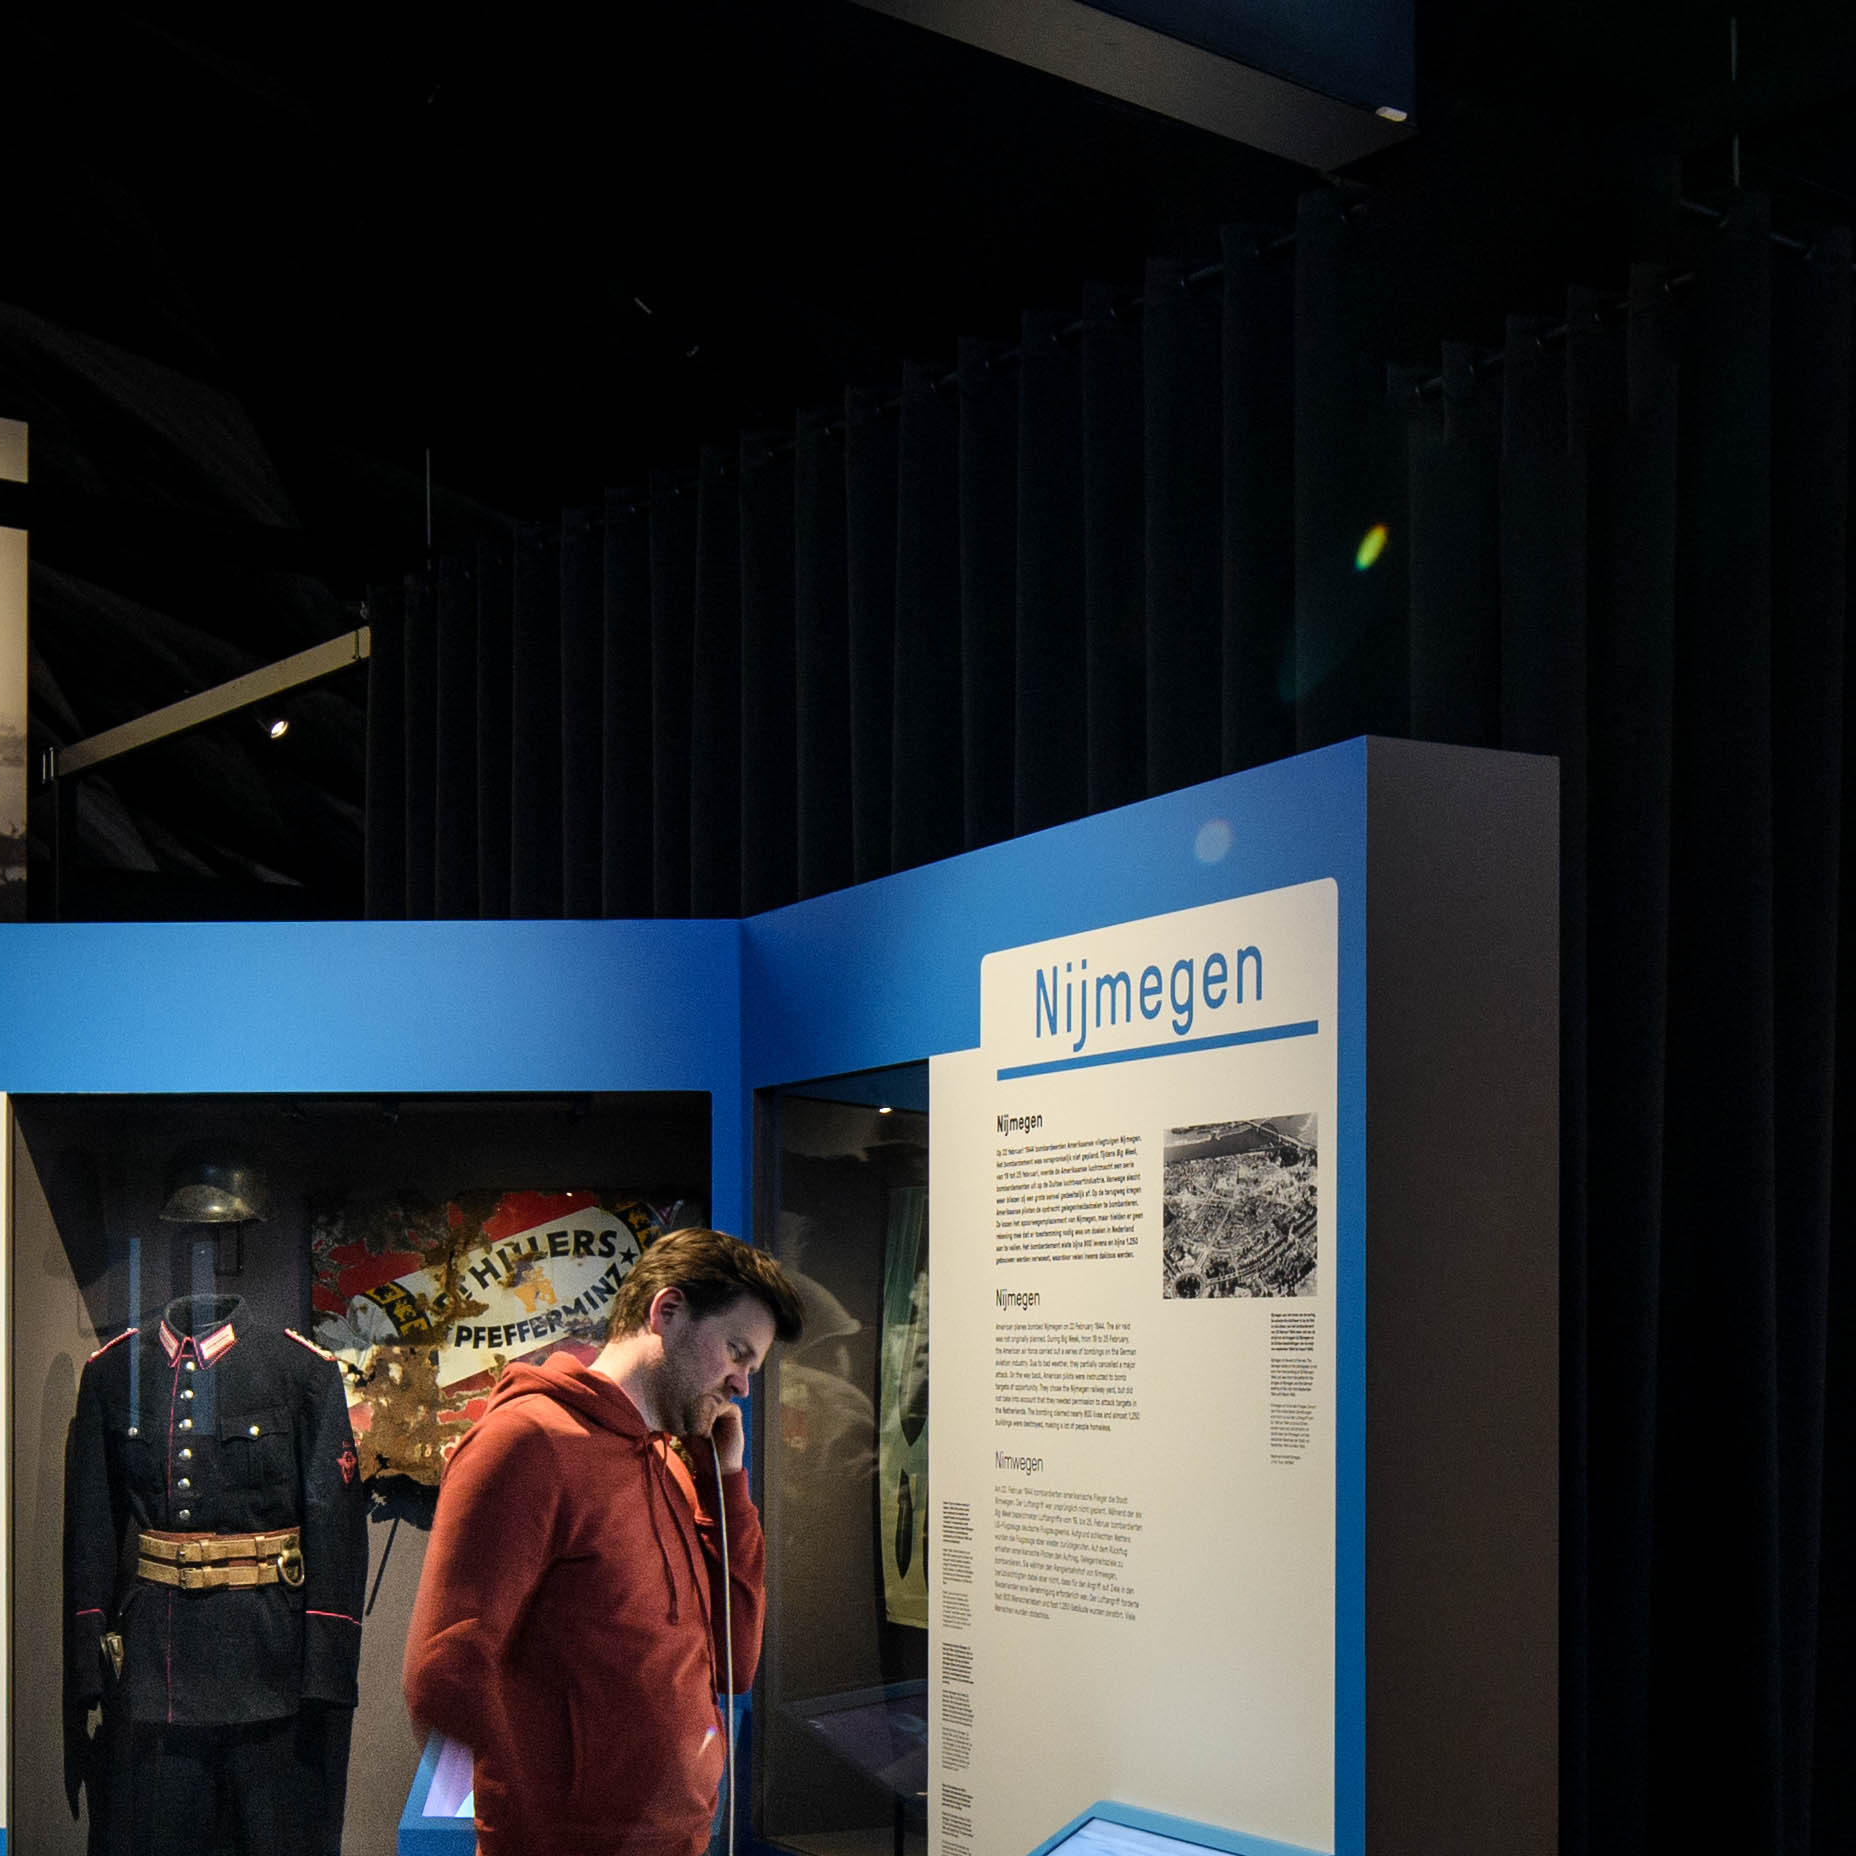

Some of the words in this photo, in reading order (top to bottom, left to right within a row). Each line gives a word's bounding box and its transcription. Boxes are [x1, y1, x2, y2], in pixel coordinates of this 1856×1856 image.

[1035, 943, 1264, 1052] Nijmegen
[996, 1113, 1043, 1136] Nijmegen
[454, 1261, 626, 1350] PFEFFERMINZ
[995, 1288, 1041, 1311] Nijmegen
[995, 1450, 1044, 1476] Nimwegen
